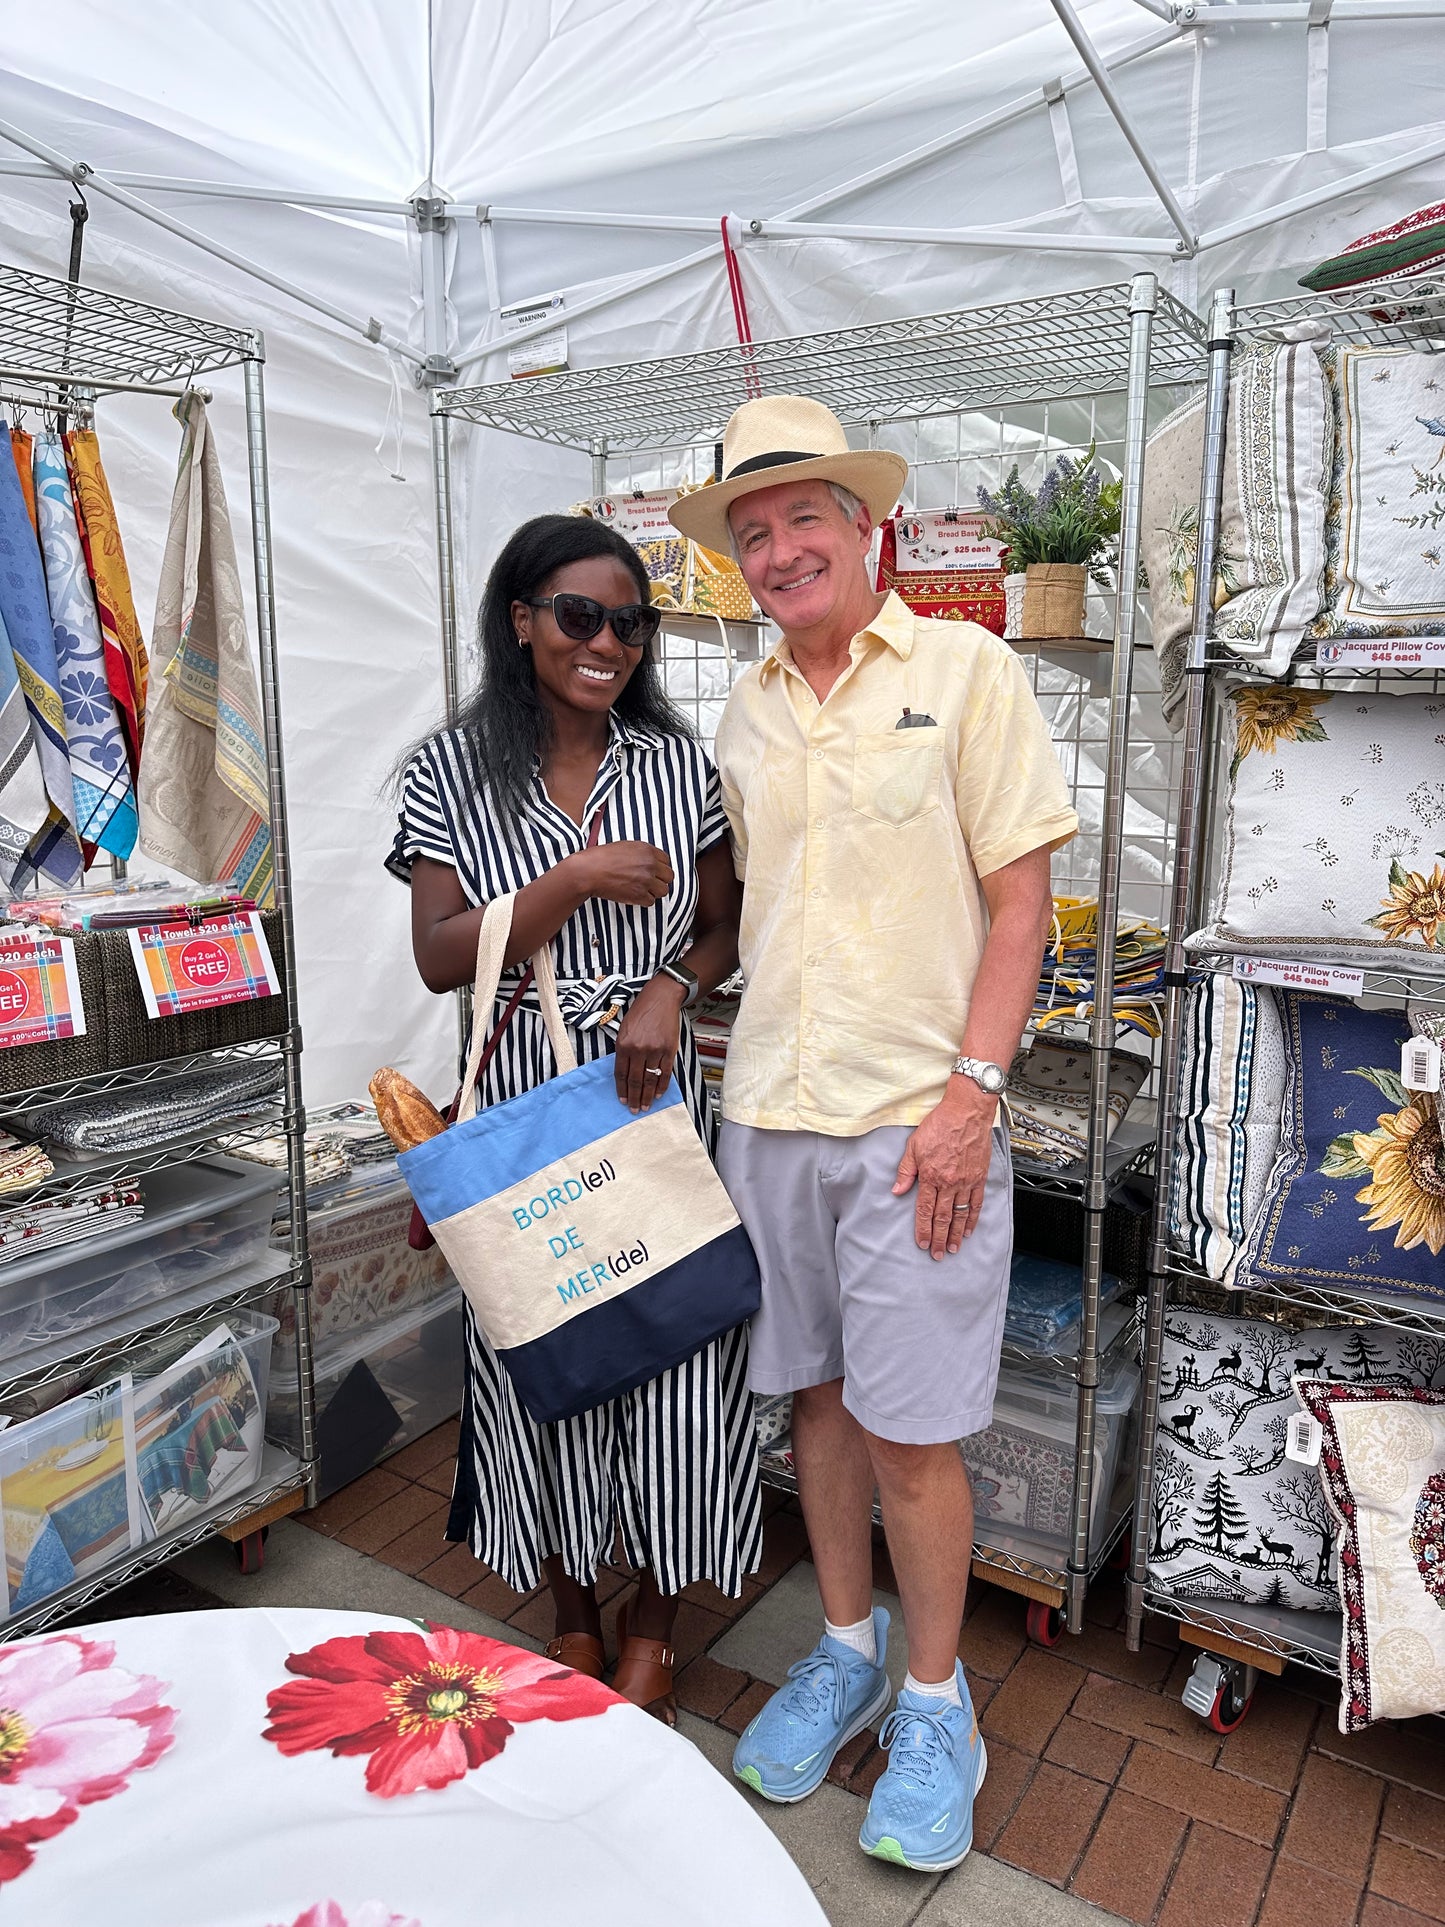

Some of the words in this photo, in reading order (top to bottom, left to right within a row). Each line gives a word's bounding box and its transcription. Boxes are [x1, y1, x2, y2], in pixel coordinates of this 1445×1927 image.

[518, 312, 547, 323] WARNING
[938, 530, 959, 538] Bread
[961, 529, 978, 537] Bask
[954, 545, 970, 554] $25
[971, 545, 991, 553] each
[1342, 641, 1389, 652] Jacquard
[1391, 641, 1423, 651] Pillow
[1425, 641, 1445, 651] Cov
[1371, 652, 1392, 662] $45
[1394, 652, 1422, 662] each
[142, 932, 162, 943] Tea
[163, 928, 197, 940] Towel:
[198, 923, 219, 934] $20
[221, 919, 247, 931] each
[25, 947, 56, 960] each
[184, 952, 197, 963] Buy
[197, 951, 204, 961] 2
[204, 952, 217, 960] Get
[217, 949, 223, 958] 1
[187, 960, 227, 979] FREE
[1256, 959, 1300, 973] Jacquard
[1302, 965, 1330, 977] Pillow
[1332, 970, 1361, 982] Cover
[0, 984, 14, 992] Get
[15, 981, 21, 991] 1
[1283, 972, 1302, 983] $45
[1304, 976, 1329, 987] each
[0, 994, 24, 1010] EE
[173, 1001, 191, 1009] Made
[198, 996, 219, 1005] France
[236, 989, 257, 998] Cotton
[12, 1033, 31, 1041] 100%
[32, 1029, 56, 1039] Cotton
[511, 1158, 617, 1231] BORD(el)
[547, 1226, 585, 1260] DE
[556, 1239, 650, 1305] MER(de)
